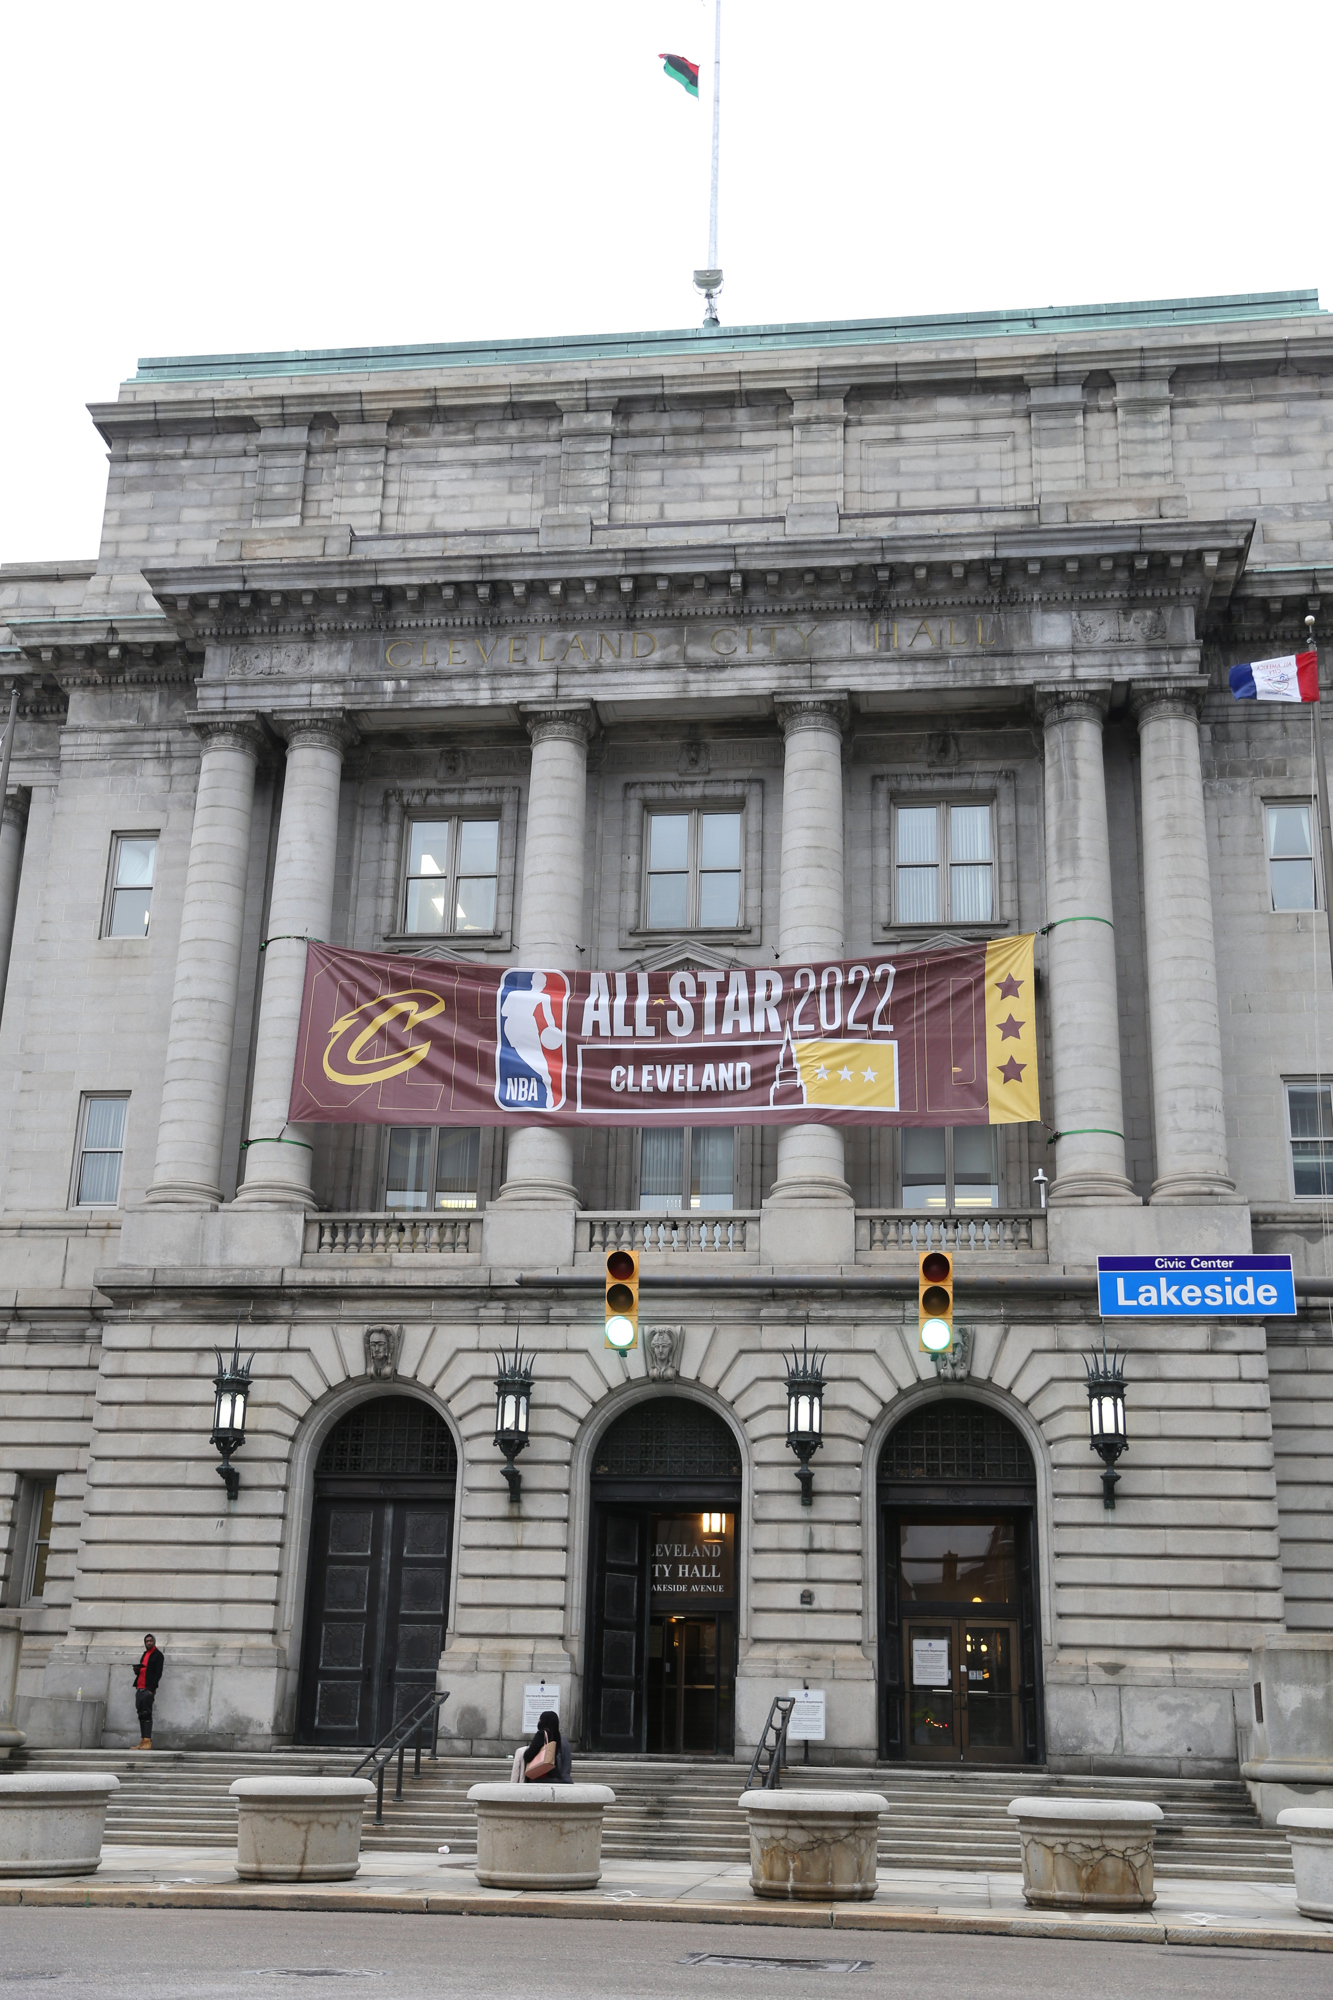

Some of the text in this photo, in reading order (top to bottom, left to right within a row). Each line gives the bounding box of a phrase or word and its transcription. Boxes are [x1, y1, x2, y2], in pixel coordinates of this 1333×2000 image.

[385, 618, 996, 668] CLEVELAND CITY HALL
[580, 963, 897, 1037] ALL STAR 2022
[505, 1077, 539, 1102] NBA
[610, 1061, 752, 1093] CLEVELAND
[1154, 1257, 1234, 1269] Civic Center
[1116, 1276, 1278, 1307] Lakeside
[651, 1543, 722, 1558] EVELAND
[677, 1564, 721, 1578] HALL
[689, 1584, 725, 1593] AVENUE
